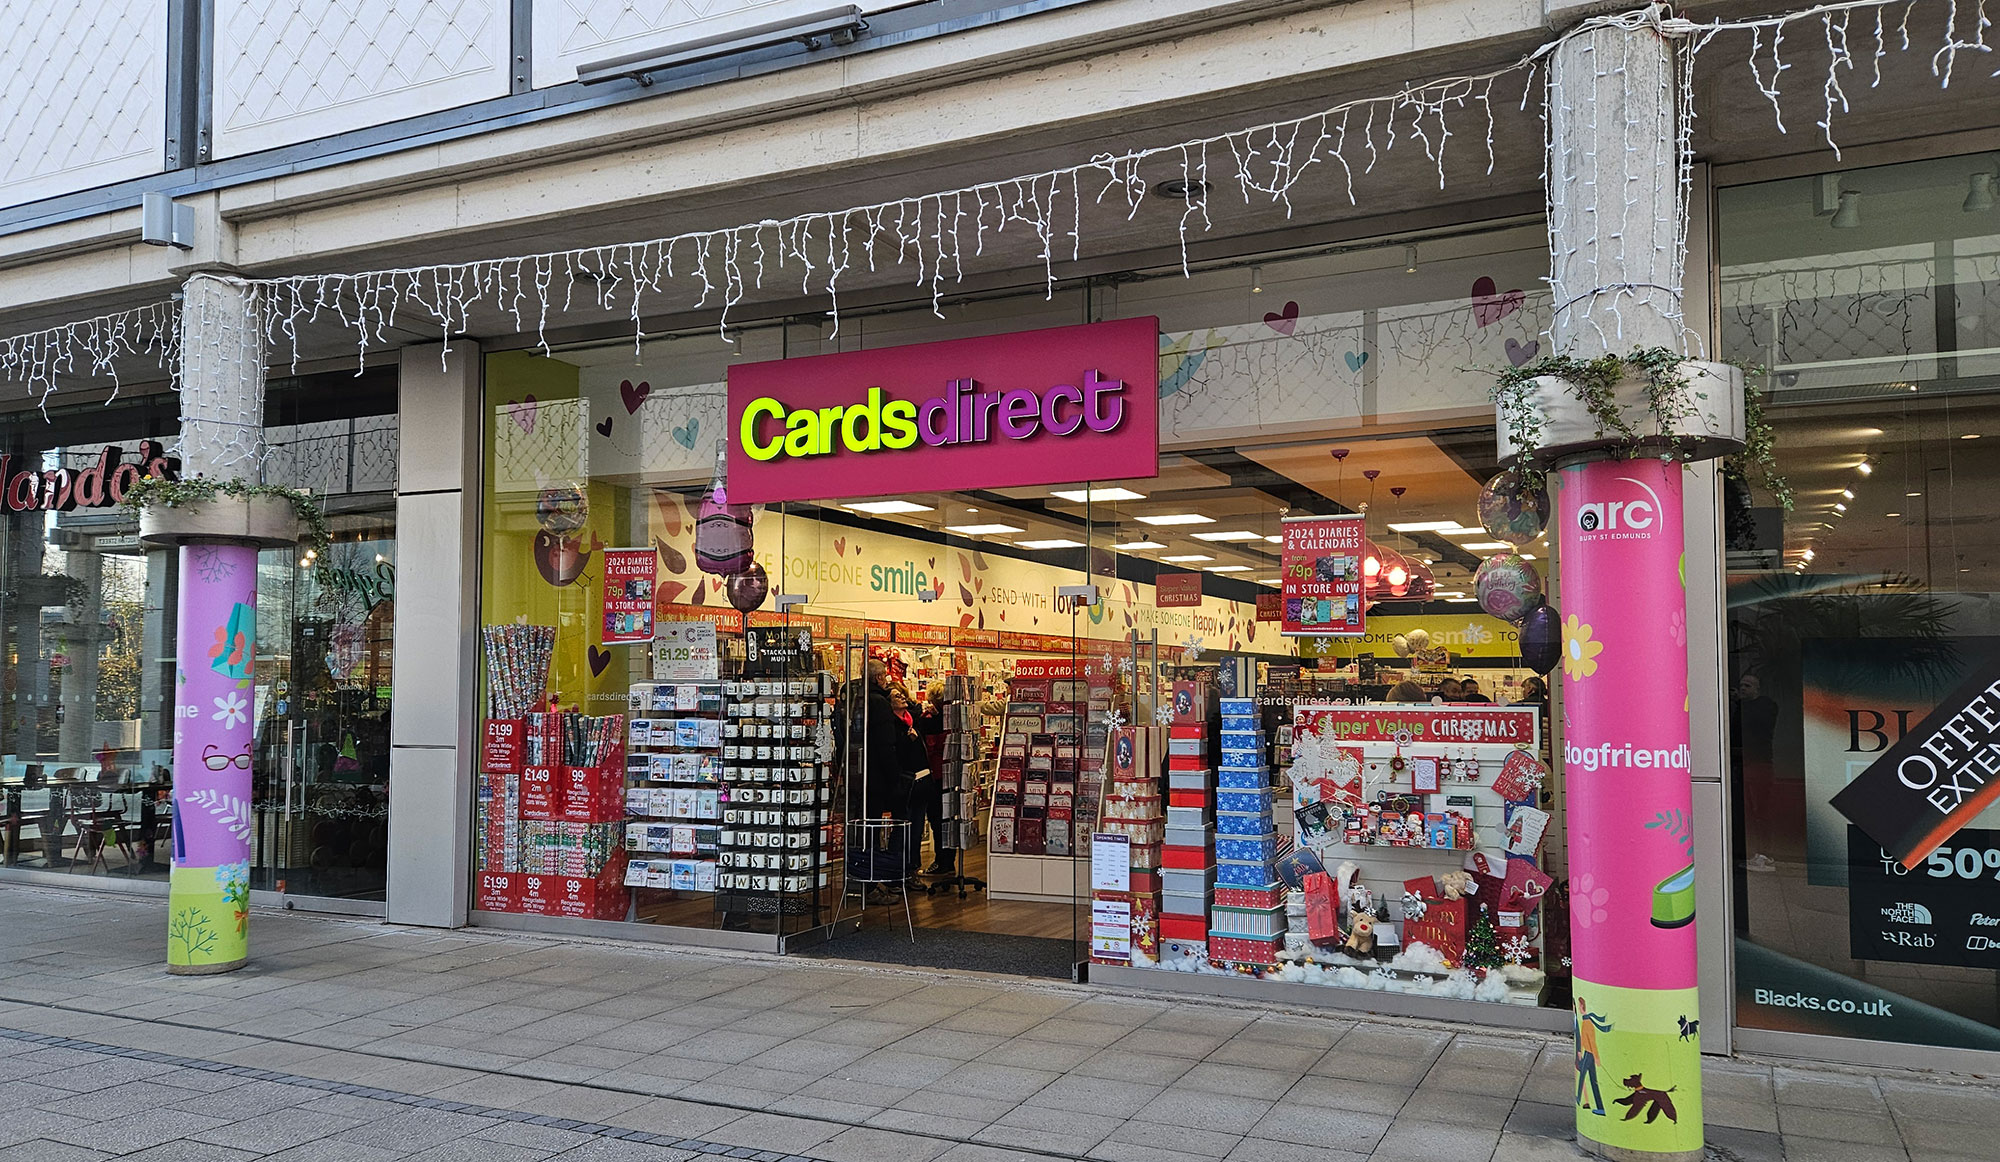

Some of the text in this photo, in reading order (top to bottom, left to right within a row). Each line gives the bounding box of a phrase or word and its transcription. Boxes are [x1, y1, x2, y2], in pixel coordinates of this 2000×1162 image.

[740, 368, 1123, 461] Cardsdirect
[1578, 500, 1653, 530] arc
[1288, 527, 1359, 539] 2024 DIARIES
[1288, 538, 1359, 550] & CALENDARS
[608, 557, 653, 566] 2024 DIARIES
[608, 566, 653, 574] & CALENDARS
[784, 556, 862, 586] SOMEONE
[870, 560, 928, 595] smile
[1288, 564, 1312, 580] 79p
[607, 586, 623, 598] 79p
[1286, 583, 1359, 594] IN STORE NOW
[991, 587, 1016, 605] SEND
[1021, 592, 1047, 609] WITH
[1160, 594, 1198, 602] CHRISTMAS
[1140, 609, 1218, 637] MAKE SOMEONE happy
[1499, 632, 1518, 641] TO
[659, 648, 689, 660] £1.29
[1016, 667, 1044, 675] BOXED
[1257, 696, 1372, 706] cardsdirect.co.uk
[489, 723, 512, 736] £1.99
[1317, 717, 1370, 738] Super
[1375, 718, 1424, 735] Value
[524, 768, 549, 782] £1.49
[1880, 860, 1908, 876] TO
[484, 876, 508, 888] £1.99
[1881, 908, 1914, 916] NORTH
[1895, 902, 1914, 910] THE
[1970, 913, 2000, 926] Peter
[1898, 931, 1935, 948] Rab
[1754, 988, 1893, 1017] Blacks.co.uk
